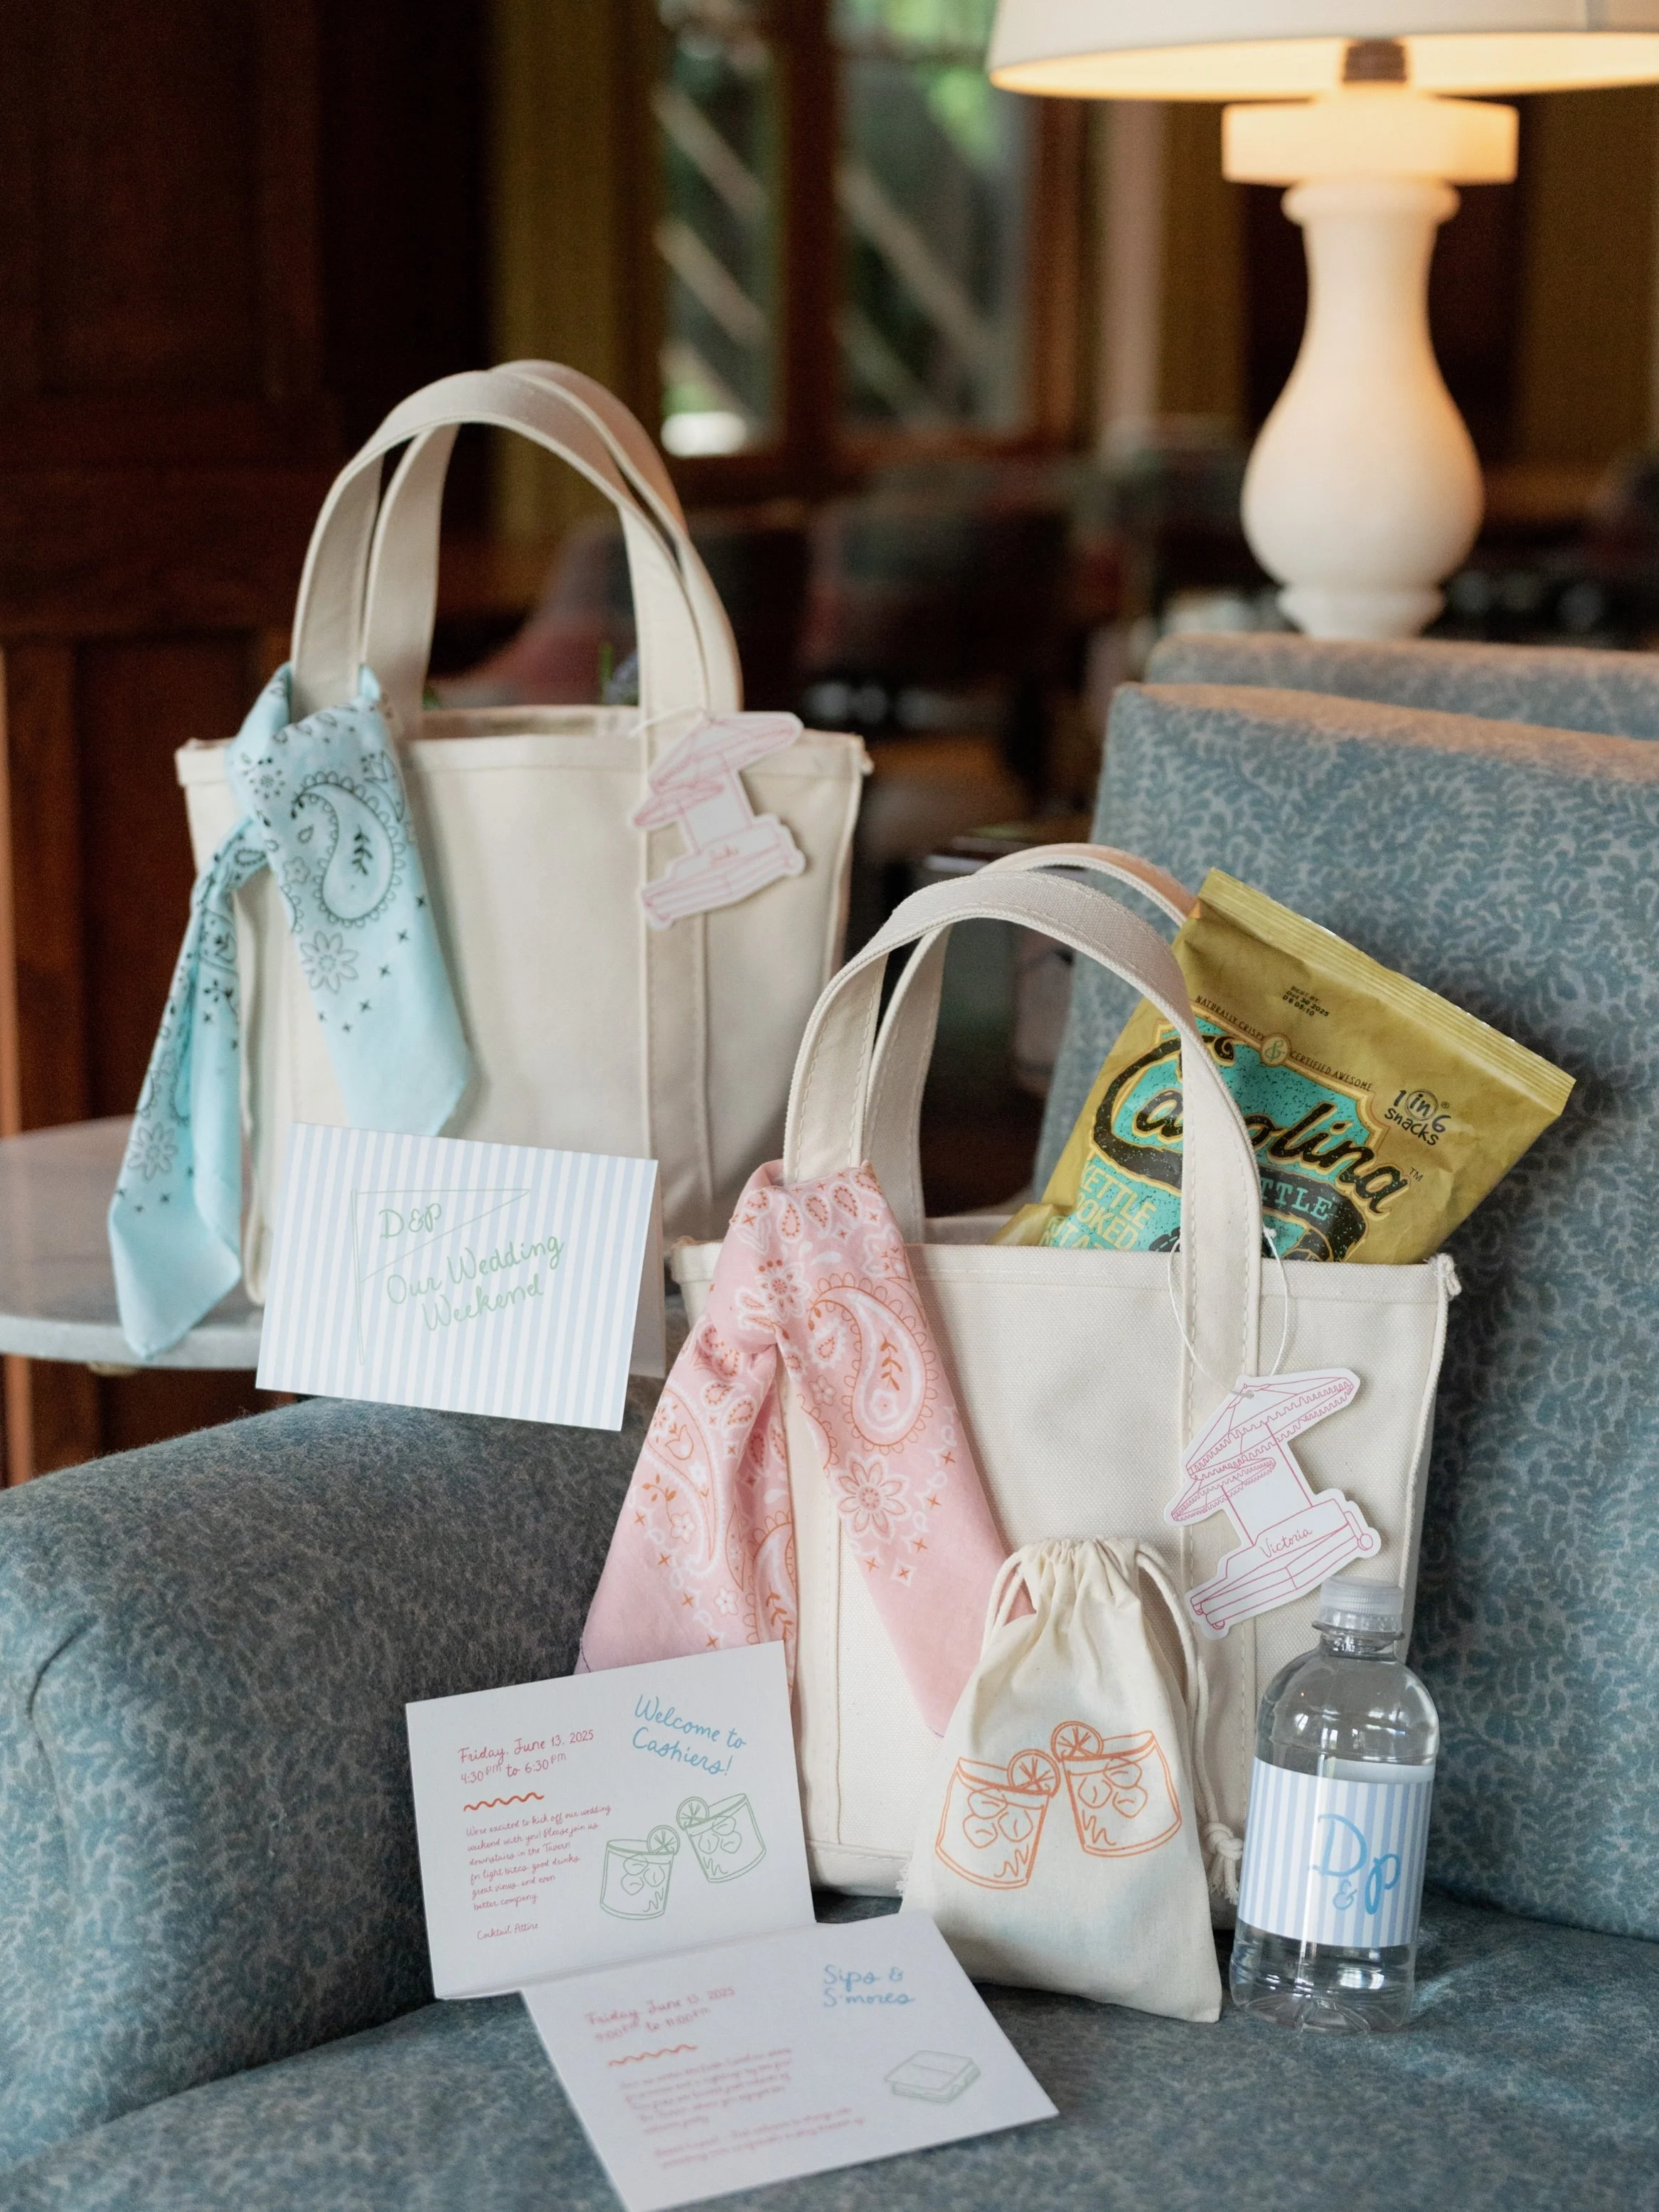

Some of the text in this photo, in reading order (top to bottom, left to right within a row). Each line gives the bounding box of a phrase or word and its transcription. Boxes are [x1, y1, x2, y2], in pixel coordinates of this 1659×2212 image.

[1311, 1003, 1330, 1016] 2025
[1195, 995, 1237, 1025] NATURALLY
[1239, 1021, 1264, 1041] CRISPY
[1291, 1050, 1332, 1075] CERTIFIED
[1333, 1070, 1373, 1091] AWESOME
[1409, 1093, 1431, 1117] in
[1093, 1034, 1408, 1213] Caolina
[1384, 1107, 1439, 1146] snacks
[1260, 1177, 1333, 1221] TTLE
[387, 1236, 564, 1304] Our Wedding
[422, 1274, 544, 1331] Weekend
[1259, 1529, 1313, 1558] Victoria
[634, 1693, 747, 1748] Welcome to
[513, 1738, 545, 1755] June
[569, 1729, 594, 1745] 2025
[633, 1726, 733, 1776] Cashiers!
[506, 1764, 520, 1777] to
[489, 1820, 520, 1832] excited
[532, 1813, 548, 1825] kick
[550, 1812, 562, 1826] off
[580, 1804, 612, 1816] wedding
[467, 1838, 501, 1851] weekend
[503, 1834, 523, 1846] with
[526, 1829, 541, 1846] you!
[543, 1827, 569, 1838] Please
[569, 1824, 585, 1838] join
[469, 1854, 516, 1866] downstairs
[528, 1847, 540, 1856] the
[543, 1842, 570, 1853] Tavern
[471, 1873, 481, 1886] for
[483, 1869, 503, 1882] light
[532, 1859, 549, 1874] good
[472, 1886, 494, 1900] great
[521, 1877, 536, 1886] and
[538, 1874, 555, 1883] even
[474, 1900, 498, 1910] better
[477, 1923, 539, 1940] Cocktail Attire
[823, 1964, 882, 1992] Sips
